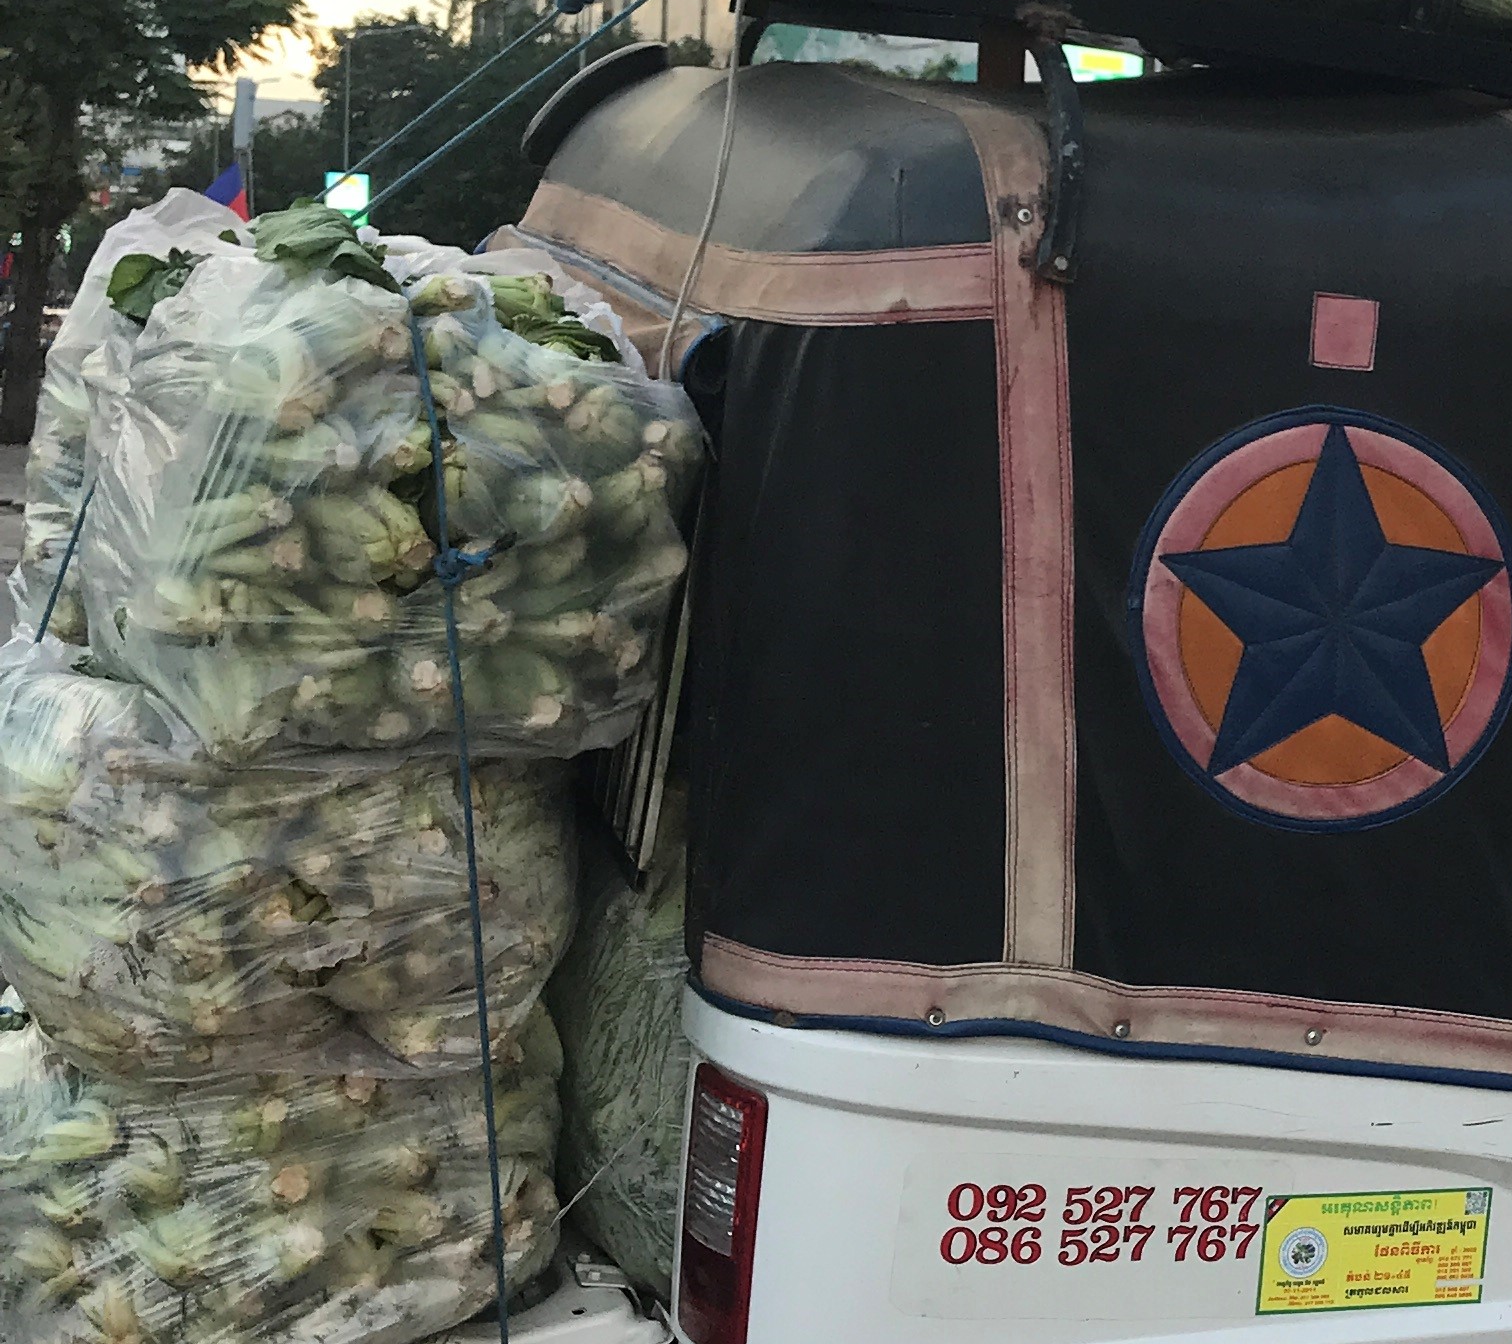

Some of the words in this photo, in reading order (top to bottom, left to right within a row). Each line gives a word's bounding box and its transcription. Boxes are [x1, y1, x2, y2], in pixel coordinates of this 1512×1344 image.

[947, 1183, 1047, 1223] 092
[1063, 1186, 1155, 1224] 527
[1172, 1186, 1262, 1223] 767
[939, 1226, 1042, 1265] 086
[1058, 1225, 1155, 1265] 527
[1166, 1224, 1260, 1262] 767
